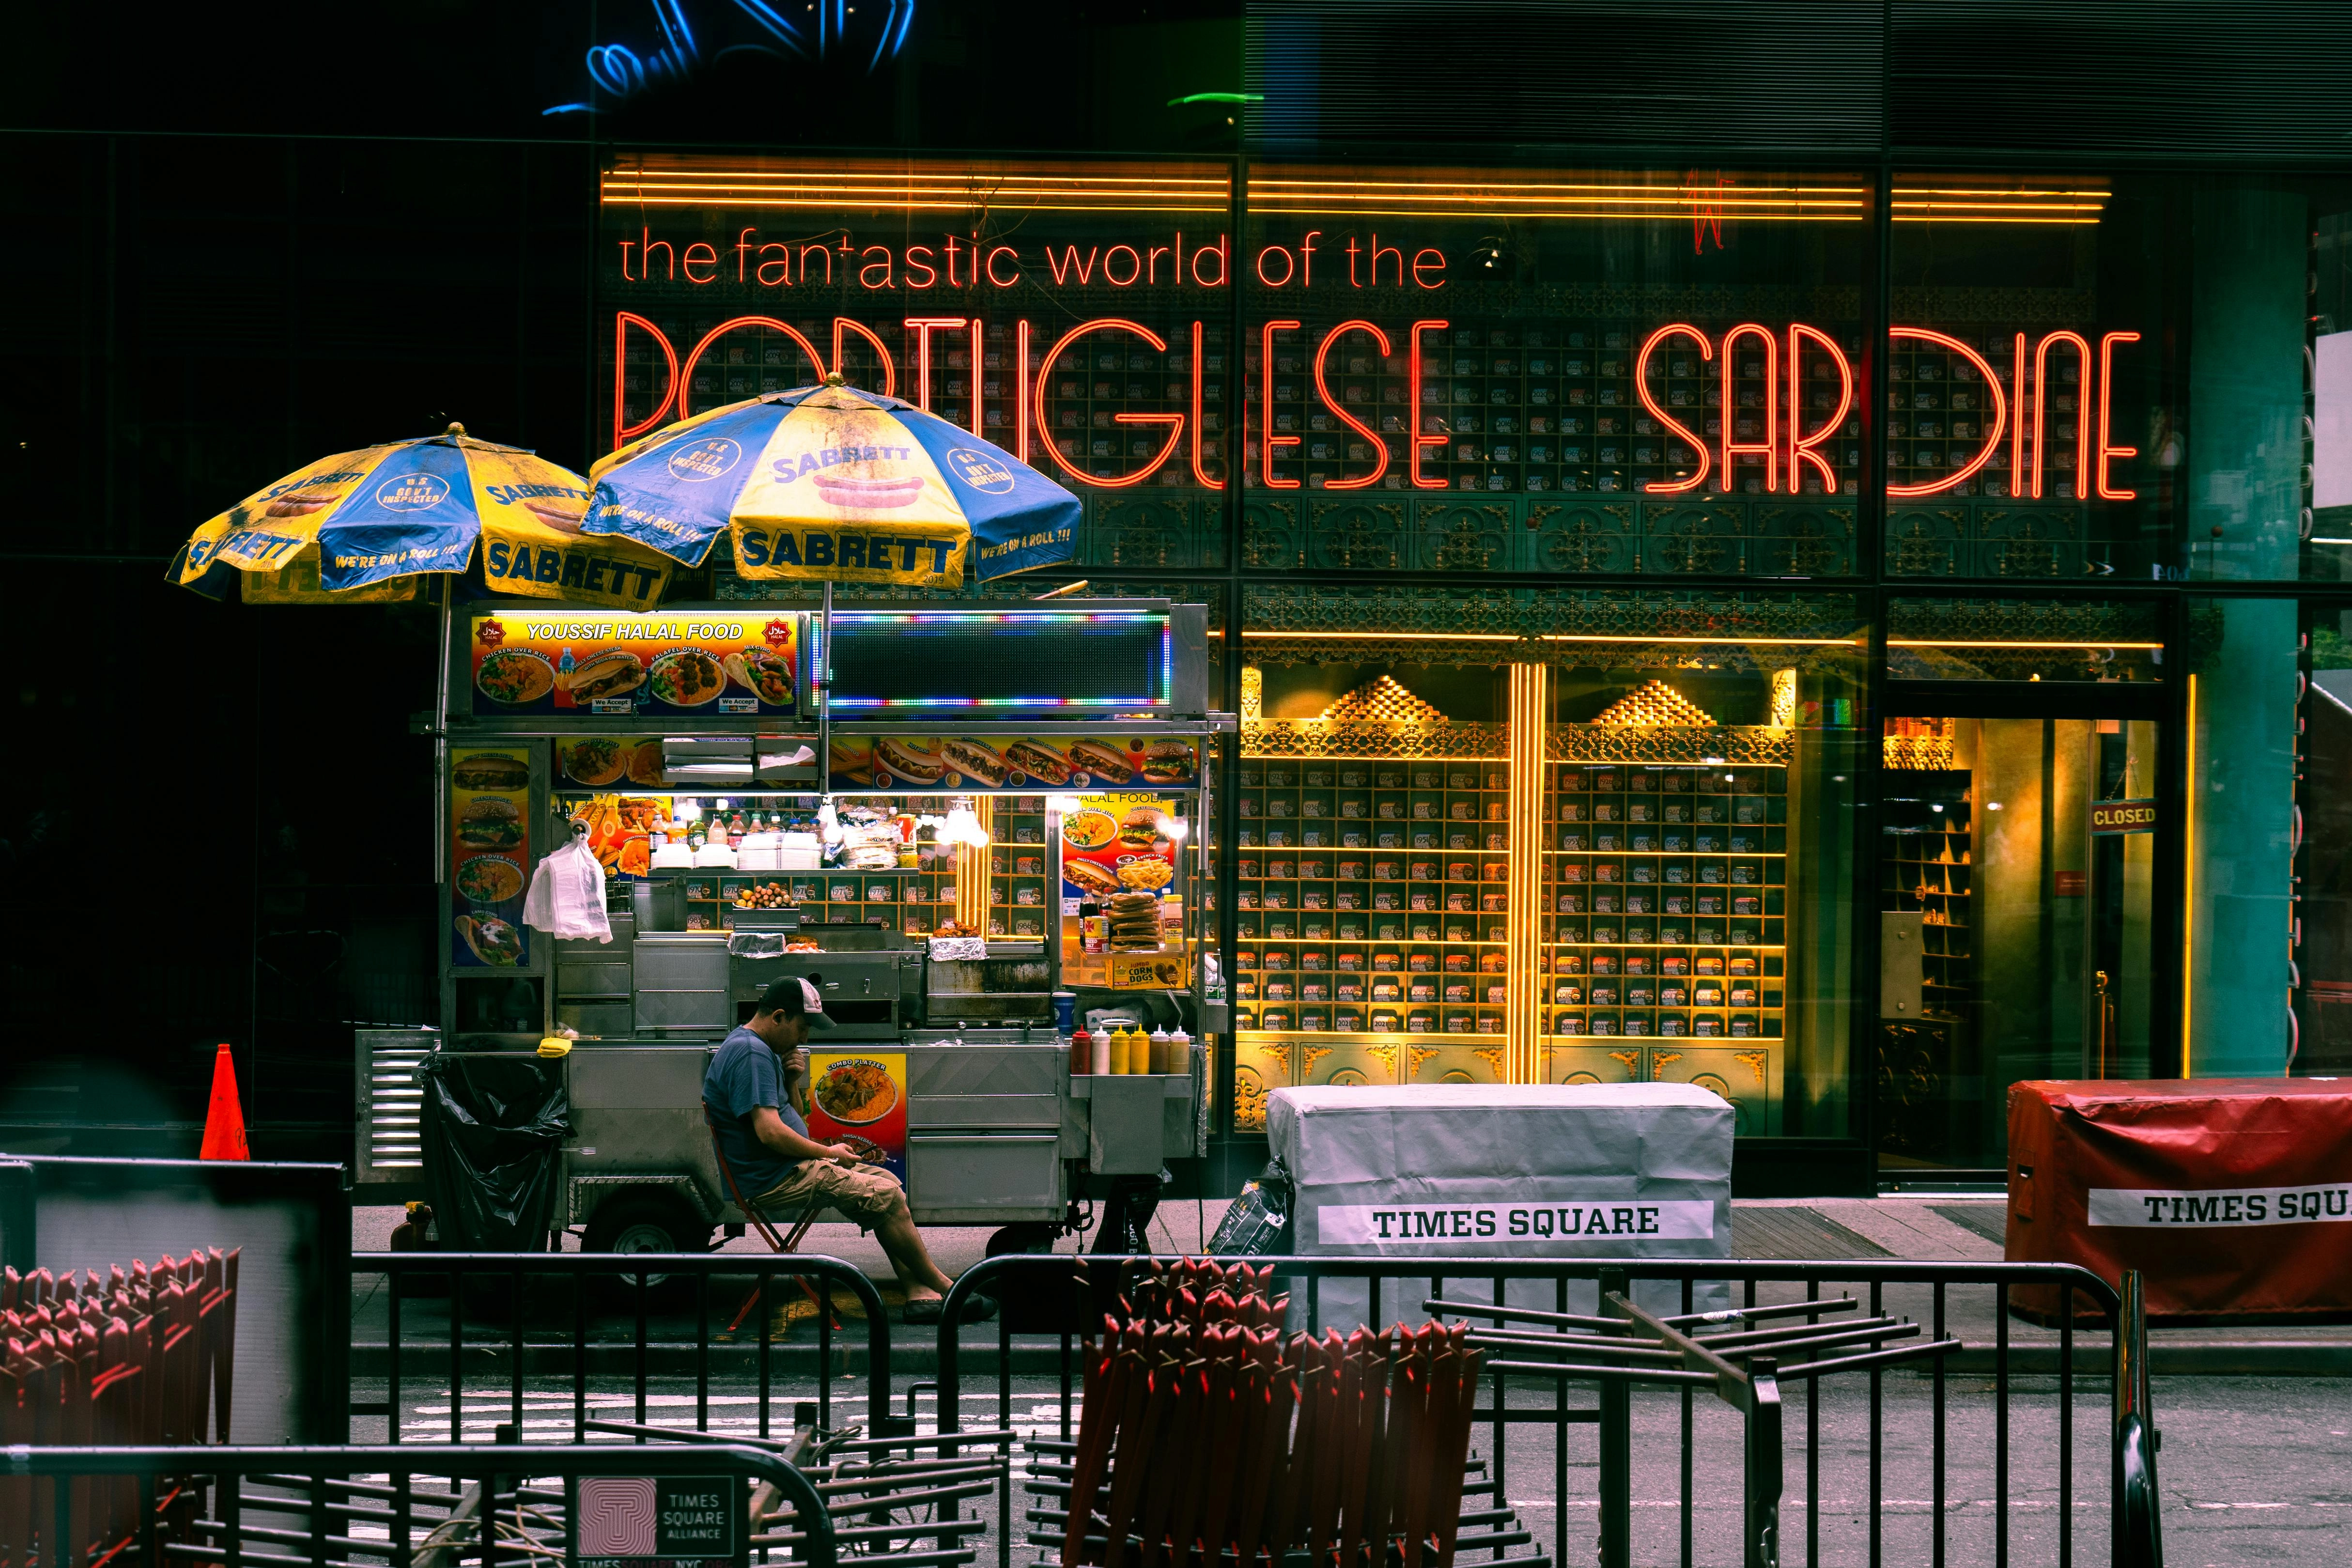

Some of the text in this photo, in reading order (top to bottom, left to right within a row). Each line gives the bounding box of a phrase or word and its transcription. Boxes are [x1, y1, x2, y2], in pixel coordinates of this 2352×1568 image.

[619, 225, 1446, 289] the fantastic world of the
[1635, 321, 2141, 499] SARDINE
[672, 457, 722, 477] INSPECTED
[767, 444, 911, 484] SABRETT
[257, 472, 366, 502] SABRETT
[968, 471, 1011, 487] INSPECTED
[383, 495, 440, 503] INSPECTED
[396, 487, 432, 496] GOV'T
[484, 483, 588, 505] SABRETT
[599, 505, 629, 517] WE'RE
[627, 510, 647, 522] ON
[643, 514, 655, 524] A
[653, 517, 685, 537] ROLL
[739, 527, 958, 574] SABRETT
[981, 542, 1008, 560] WE'RE
[1009, 538, 1020, 552] ON
[1021, 535, 1027, 548] A
[1029, 531, 1055, 547] ROLL
[335, 555, 377, 569] WE'RE
[379, 553, 398, 565] ON
[398, 551, 407, 563] A
[408, 548, 439, 559] ROLL
[488, 537, 661, 600] SABRETT
[923, 574, 944, 585] 2019
[526, 623, 744, 640] YOUSSIF HALAL FOOD
[481, 647, 512, 663] CHICKEN
[534, 650, 552, 663] RICE
[650, 646, 721, 663] FALAFEL OVER RICE
[754, 645, 771, 654] GYRO
[571, 645, 622, 671] PHILLY CHEESE STEAK
[583, 662, 596, 672] WITH
[594, 656, 609, 666] SODA
[573, 740, 589, 748] LAMB
[605, 740, 620, 748] RICE
[837, 740, 860, 757] CHURROS
[907, 741, 918, 750] HOT
[989, 746, 1000, 757] DOG
[470, 795, 512, 805] CHEESEBURGER
[1101, 809, 1115, 818] RICE
[1130, 805, 1164, 813] CHEESEBURGER
[2093, 808, 2156, 826] CLOSED
[460, 854, 487, 867] CHICKEN
[505, 856, 521, 868] RICE
[1102, 865, 1114, 875] STEAK
[484, 910, 498, 918] GYRO
[1128, 966, 1153, 976] CORN
[1129, 974, 1154, 983] DOGS
[826, 1058, 886, 1071] COMBO PLATTER
[857, 1135, 873, 1146] KEBAB
[2144, 1189, 2352, 1223] TIMES SQU
[1373, 1207, 1659, 1239] TIMES SQUARE
[1257, 1226, 1270, 1242] GRILLING
[668, 1494, 720, 1508] TIMES
[662, 1511, 726, 1527] SQUARE
[666, 1528, 721, 1540] ALLIANCE
